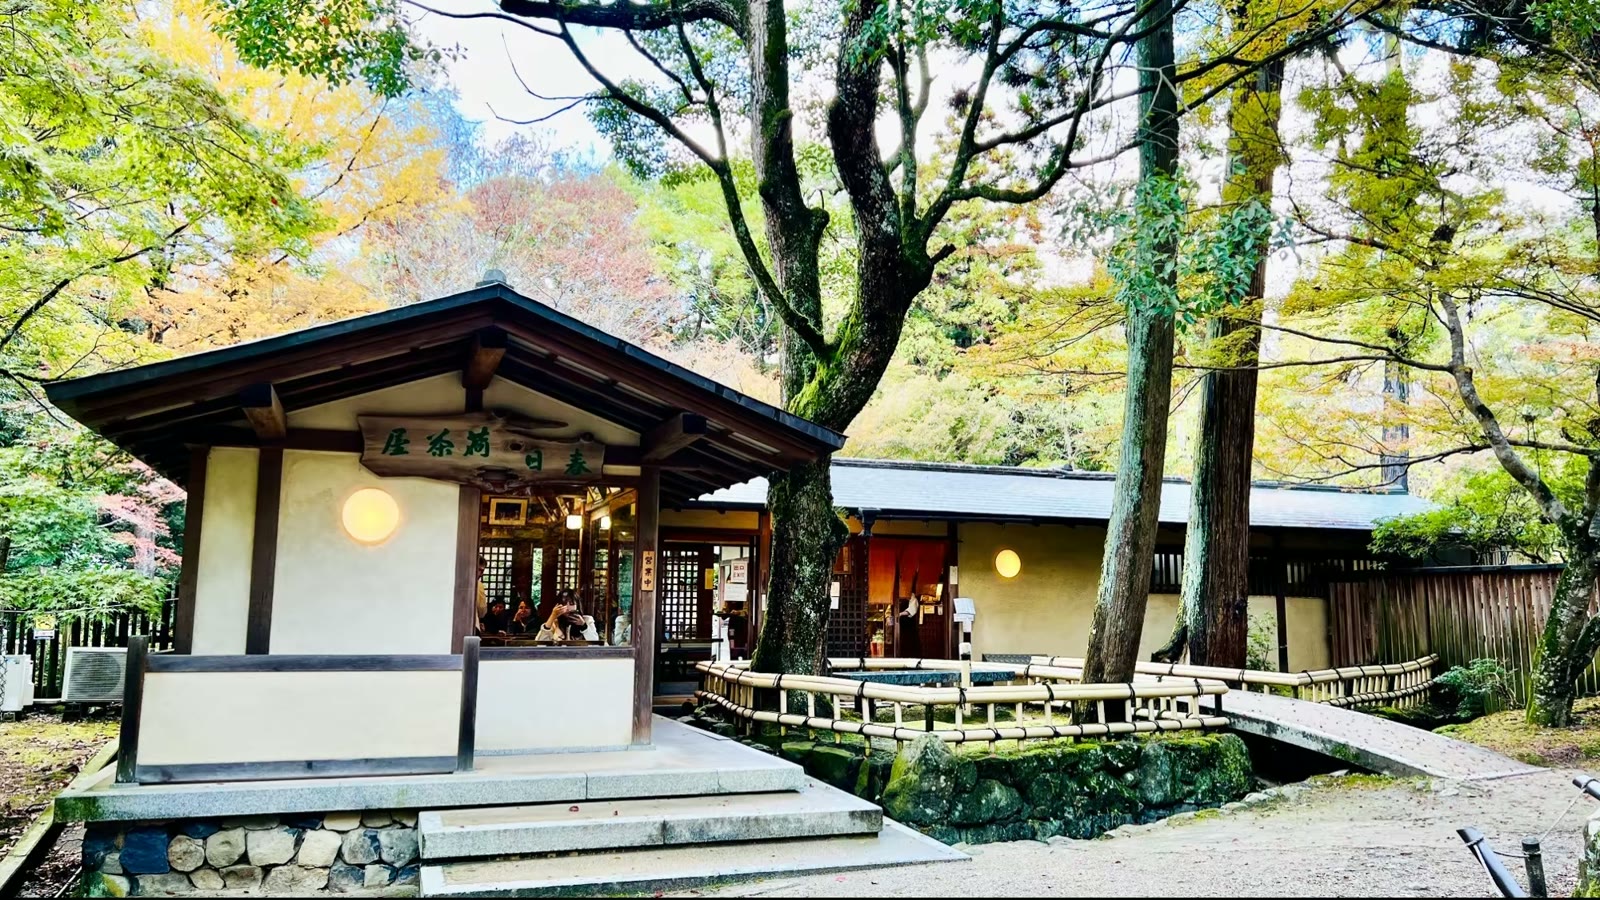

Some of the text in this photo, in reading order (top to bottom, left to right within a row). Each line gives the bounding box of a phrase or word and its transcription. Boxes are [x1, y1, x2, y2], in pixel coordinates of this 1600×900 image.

[381, 426, 592, 476] 春日荷茶屋
